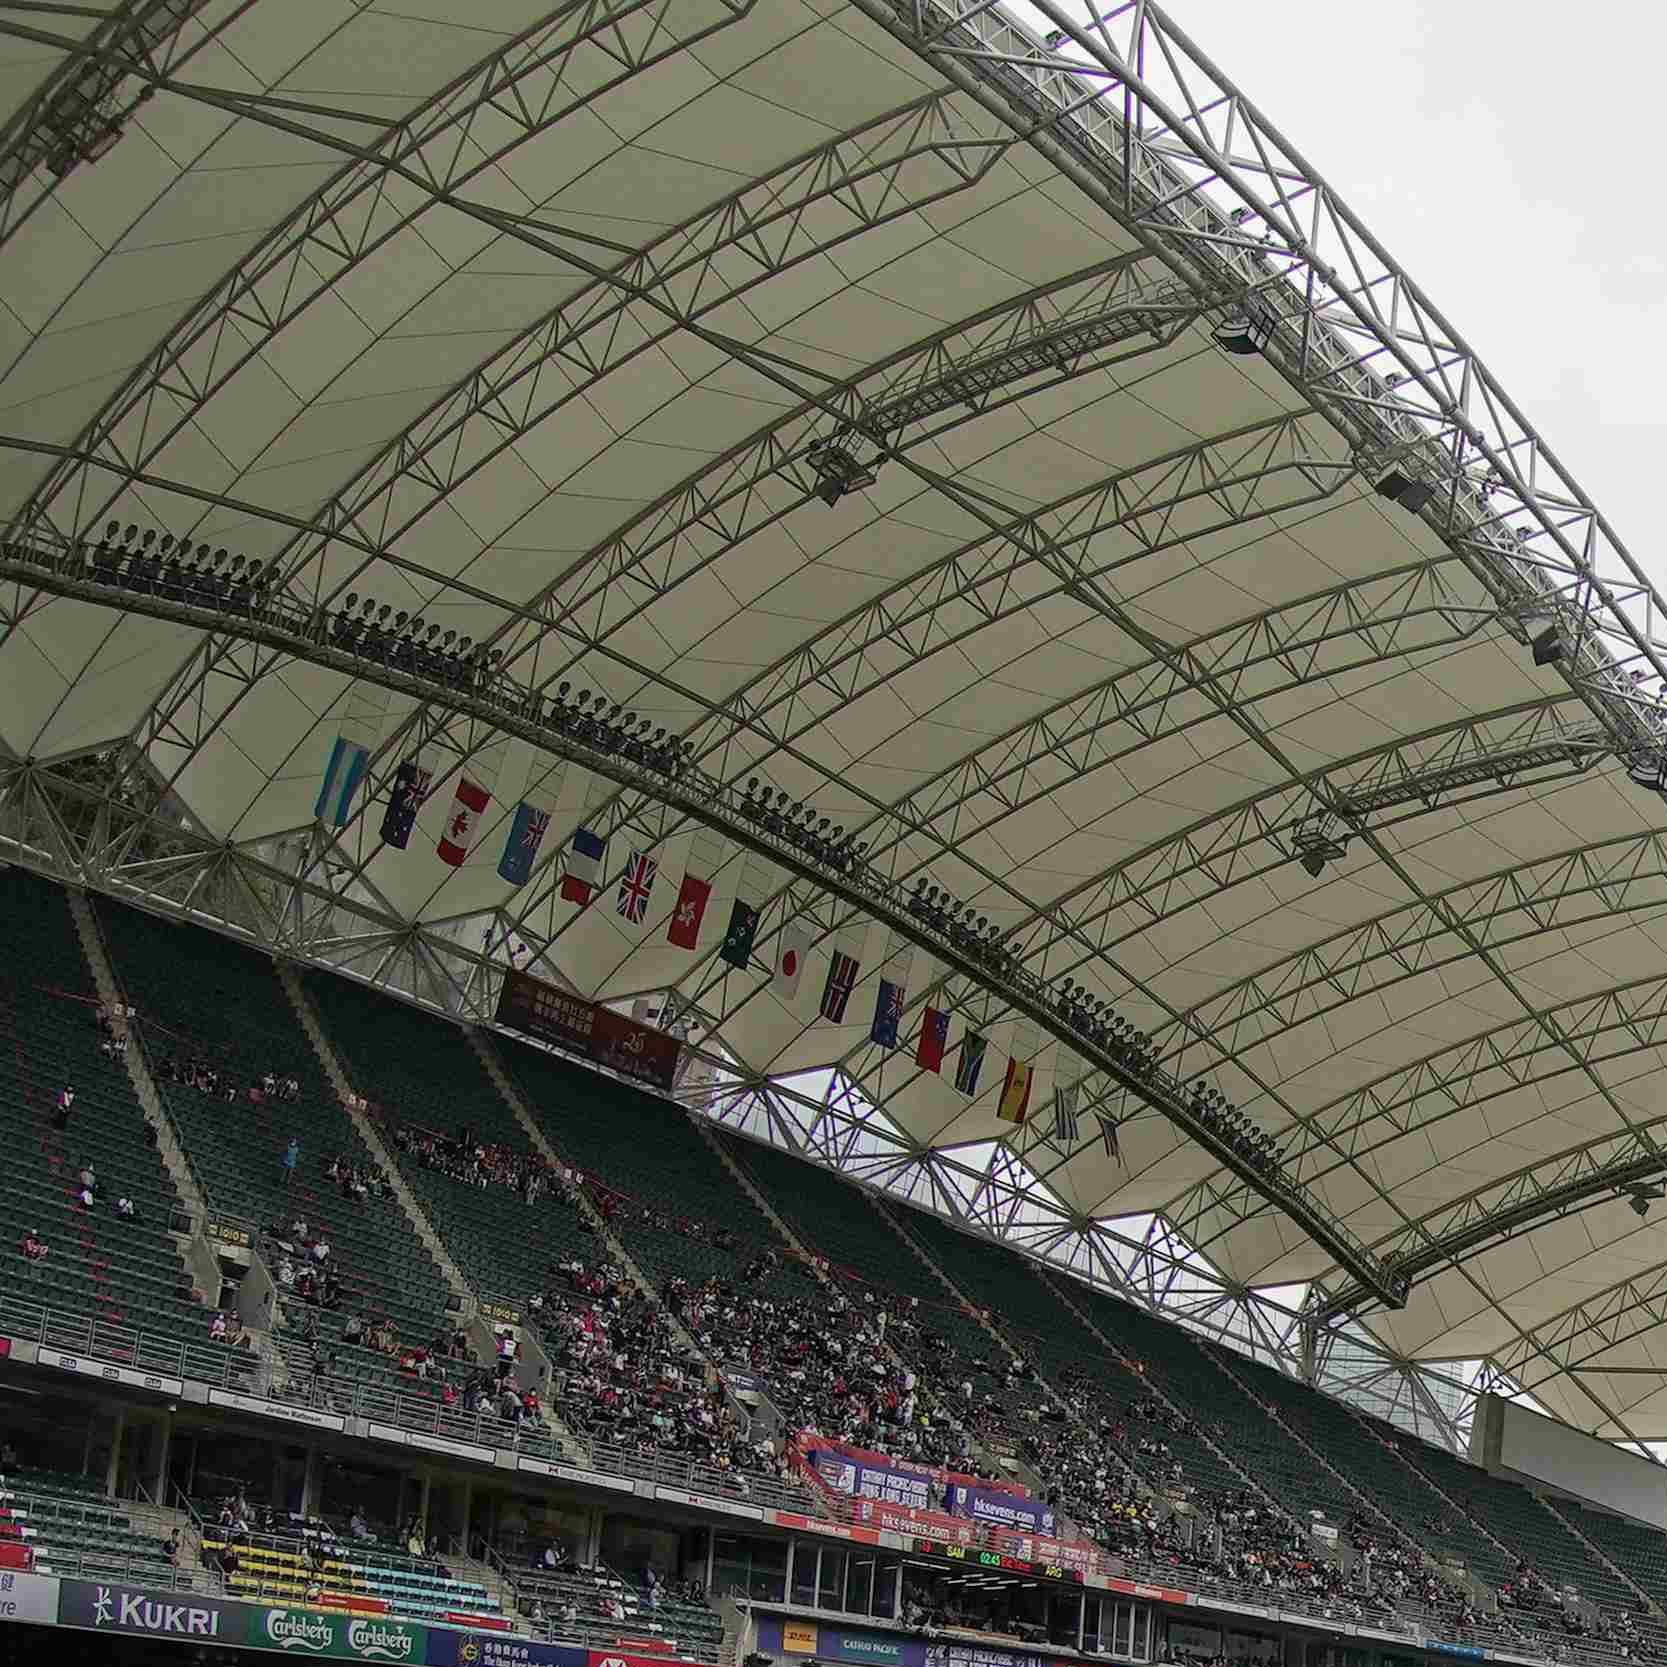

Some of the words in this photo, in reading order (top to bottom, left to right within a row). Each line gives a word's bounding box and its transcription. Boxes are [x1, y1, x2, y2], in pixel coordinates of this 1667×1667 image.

[974, 1497, 1036, 1525] hksevens.com
[119, 1592, 220, 1637] KUKRI
[266, 1608, 334, 1651] Carlsberg
[348, 1619, 413, 1660] Carlsberg
